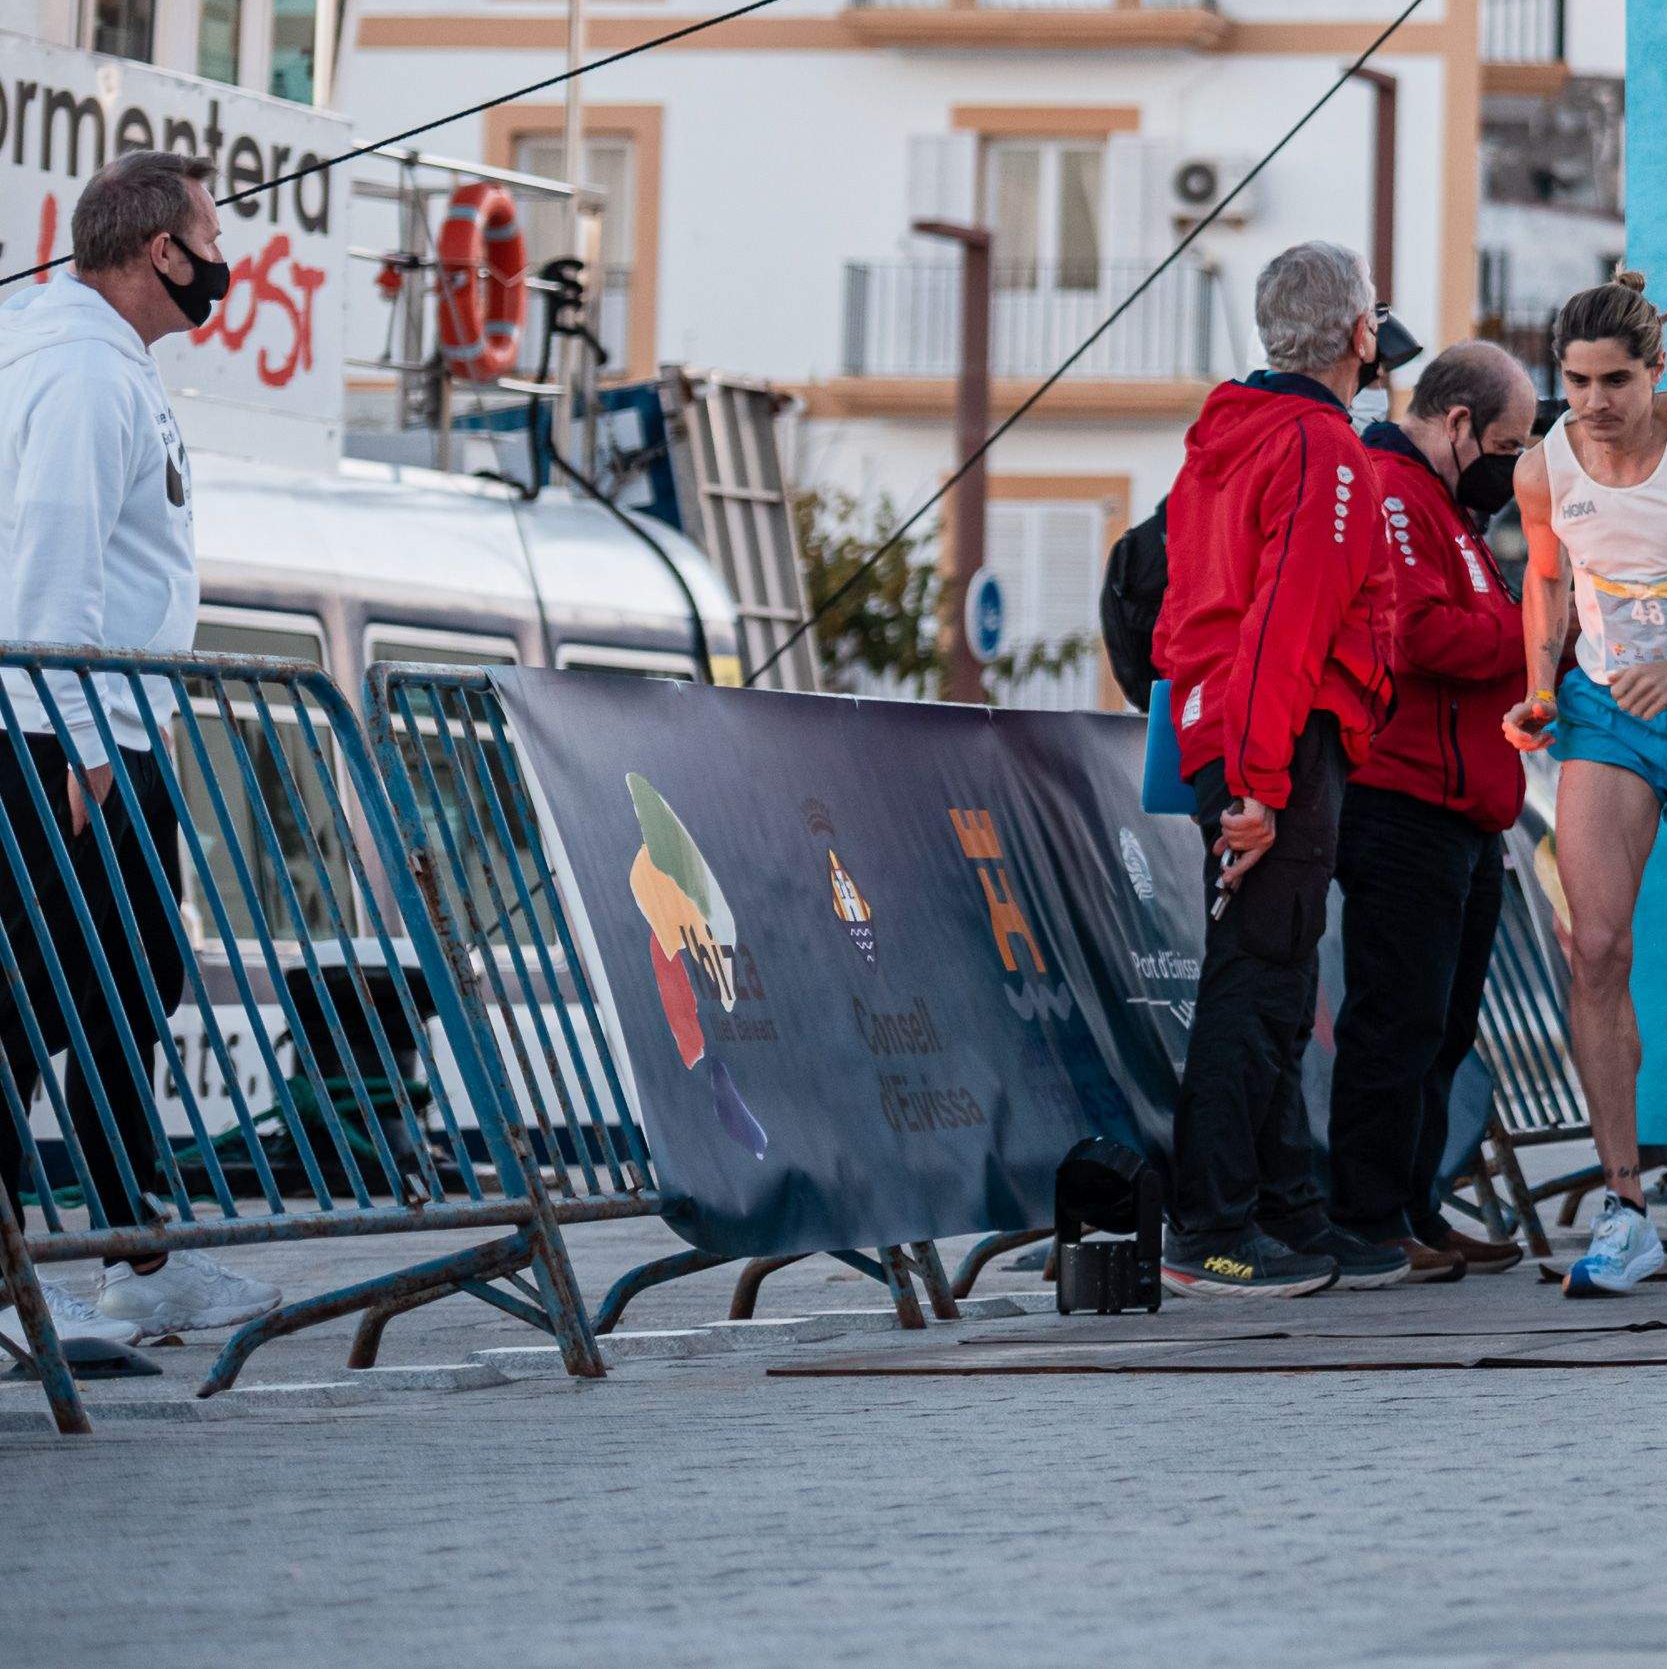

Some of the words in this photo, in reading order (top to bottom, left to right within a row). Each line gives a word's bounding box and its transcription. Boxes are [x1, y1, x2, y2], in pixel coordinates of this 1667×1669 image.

[1562, 499, 1597, 520] HOKA
[1631, 599, 1665, 626] 48
[1131, 949, 1160, 979] Port
[852, 995, 944, 1057] Consell
[876, 1071, 988, 1133] d'Eivissa
[1203, 1256, 1254, 1280] HOKA
